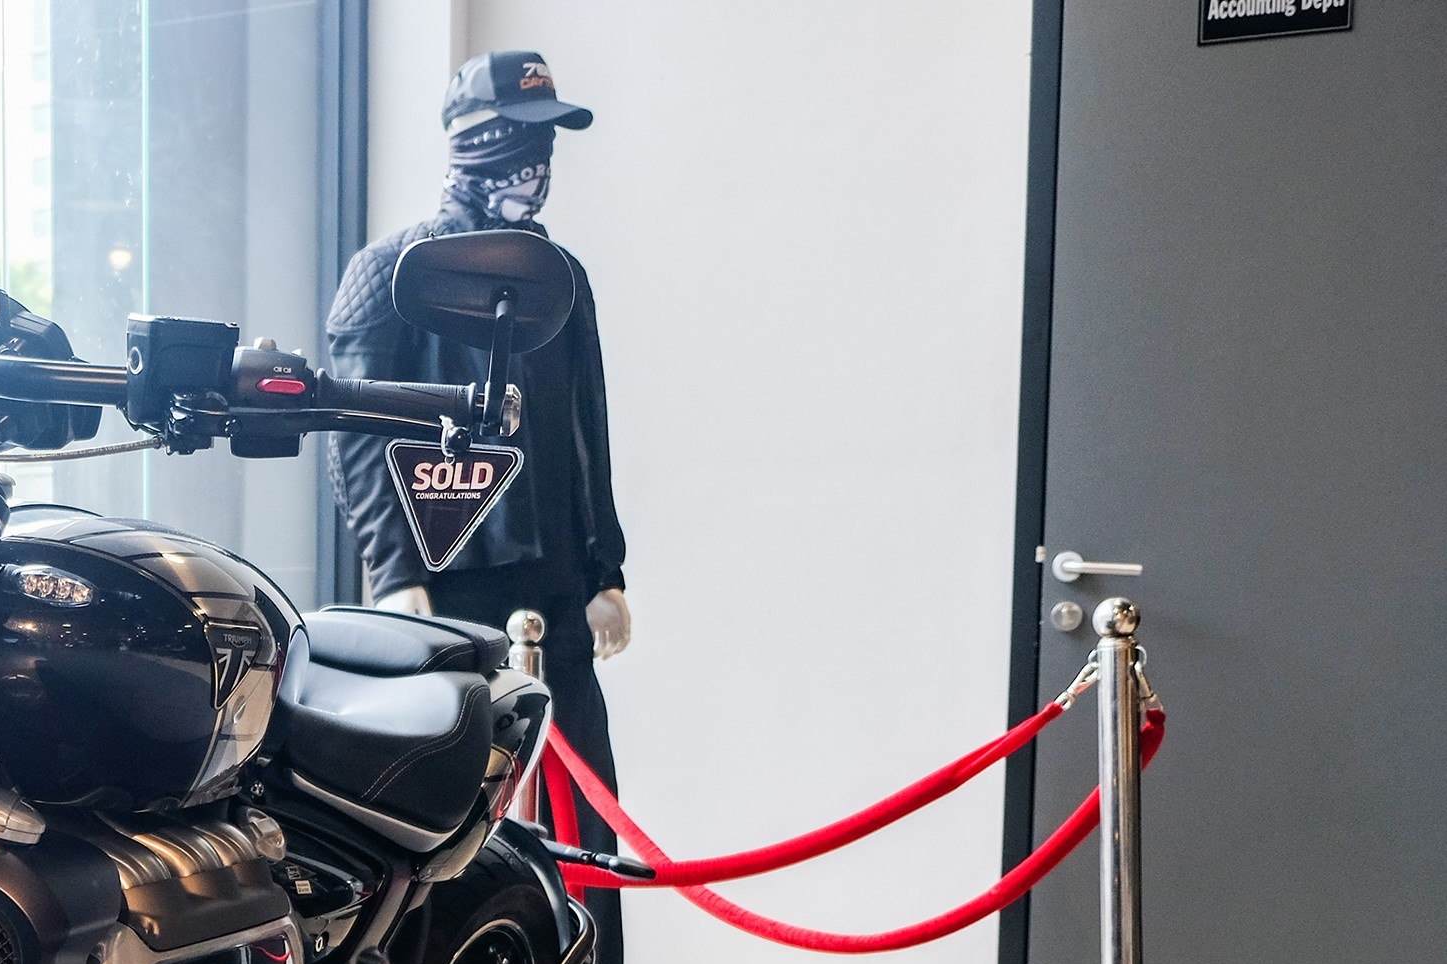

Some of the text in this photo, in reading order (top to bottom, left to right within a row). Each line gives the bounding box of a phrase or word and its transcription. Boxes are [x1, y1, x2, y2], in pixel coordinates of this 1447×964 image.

[1207, 0, 1296, 20] Accounting
[411, 461, 494, 491] SOLD
[415, 492, 481, 500] CONGRATULATIONS
[223, 633, 252, 645] TRIUMPH
